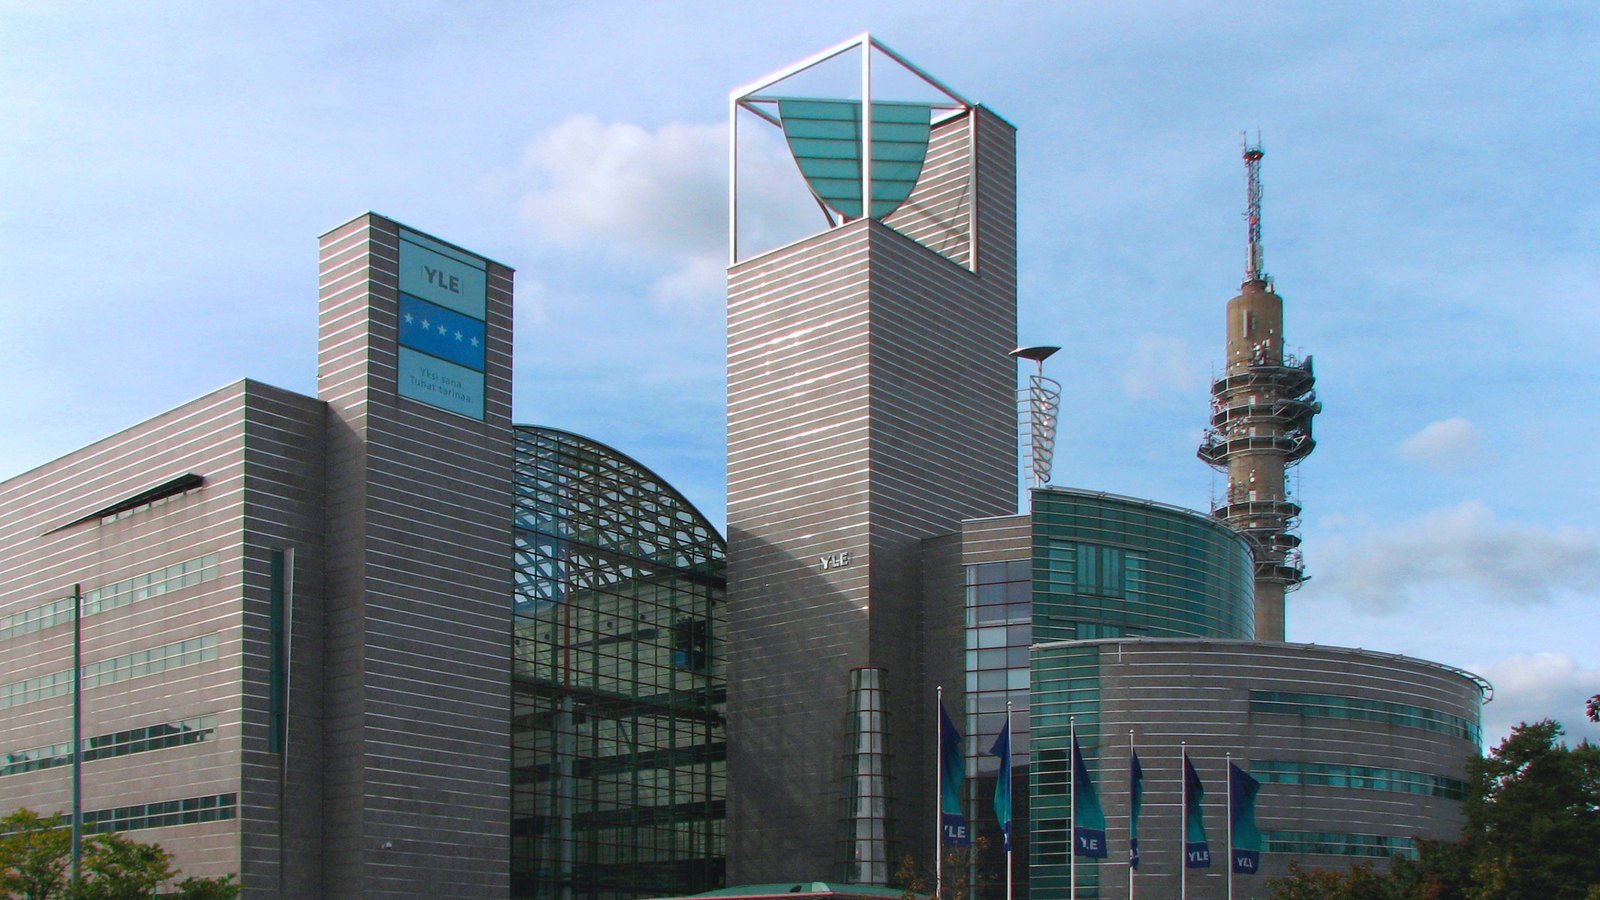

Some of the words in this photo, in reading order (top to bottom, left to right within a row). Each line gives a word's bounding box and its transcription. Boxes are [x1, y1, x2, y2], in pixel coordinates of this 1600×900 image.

[423, 265, 460, 294] YLE
[420, 367, 439, 381] Yksi
[410, 374, 436, 391] Tuhat
[820, 551, 849, 570] YLE
[1080, 836, 1098, 850] YE
[1188, 851, 1209, 862] YLE
